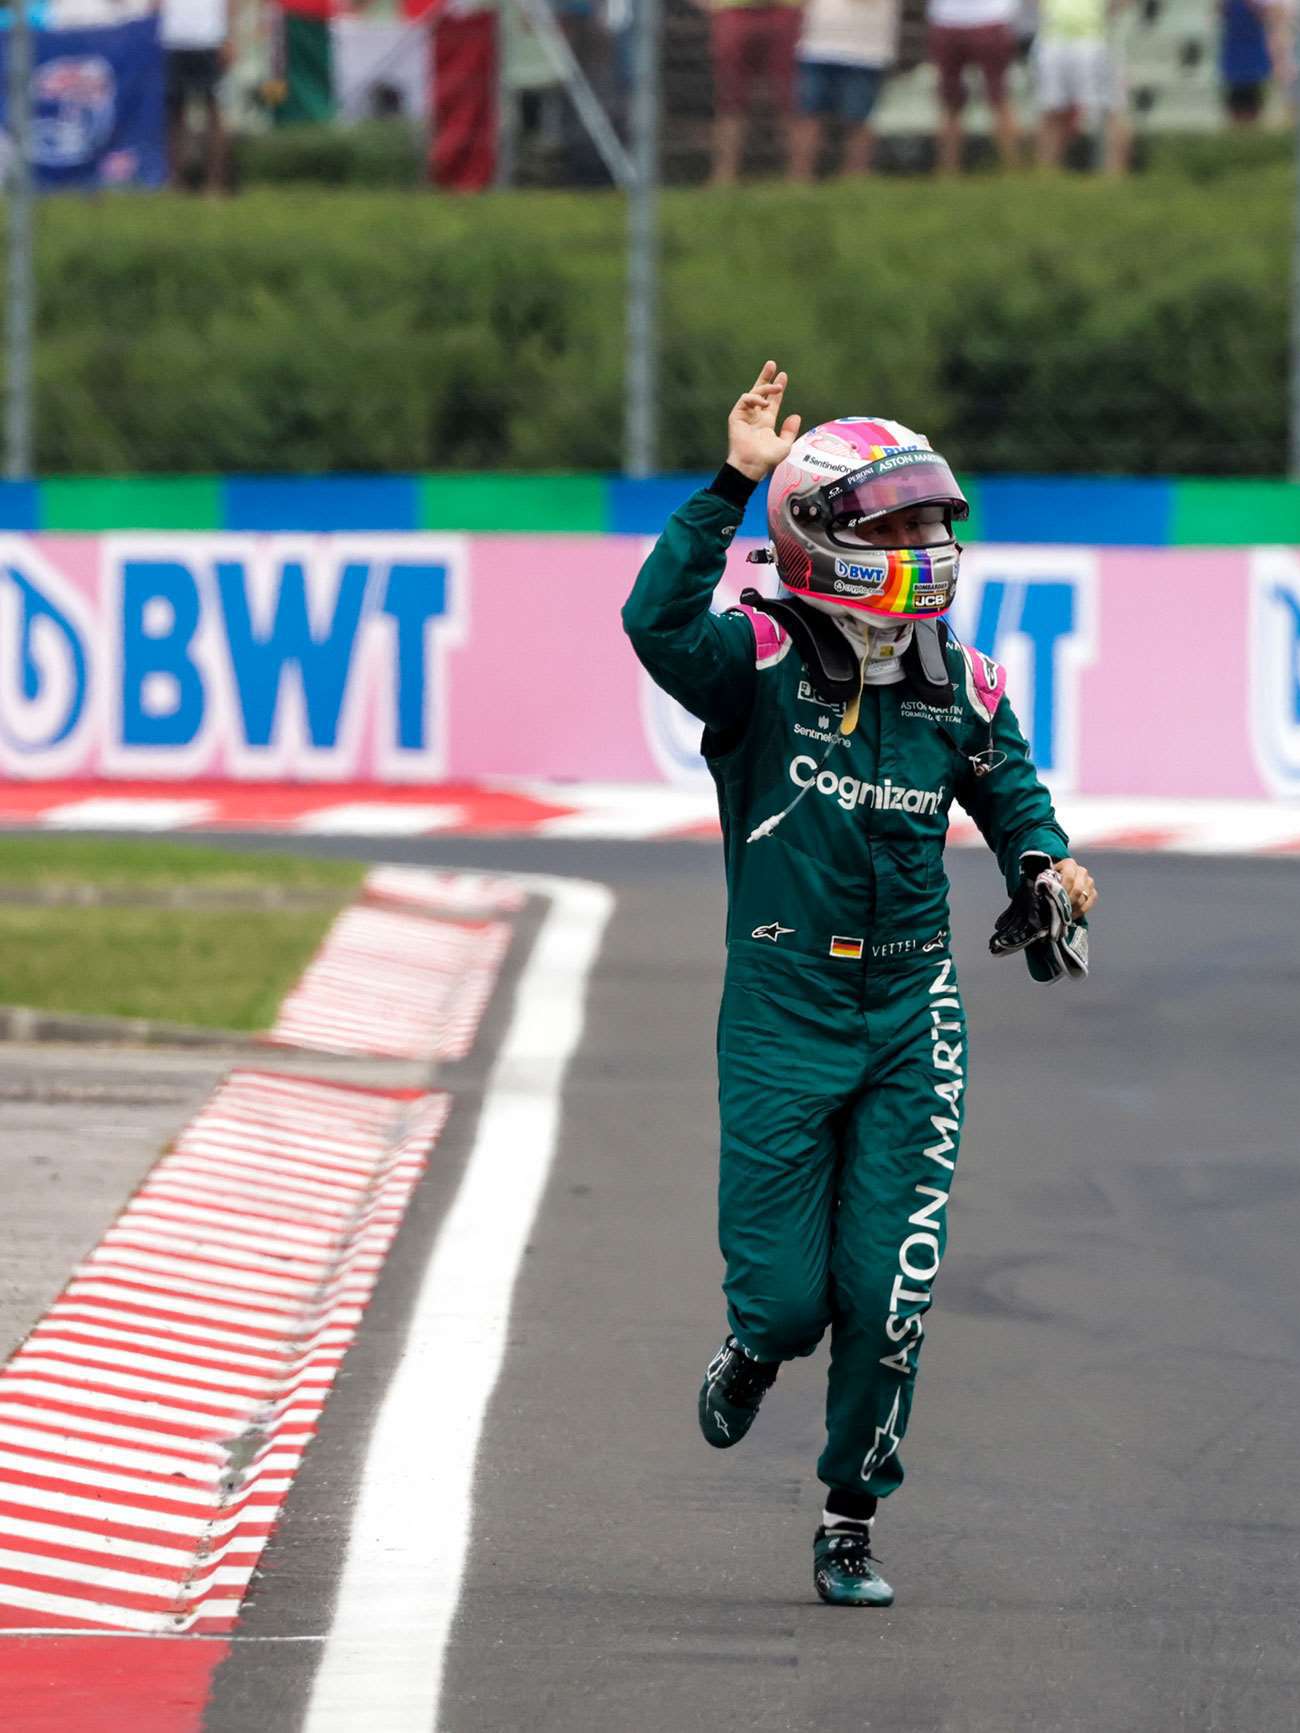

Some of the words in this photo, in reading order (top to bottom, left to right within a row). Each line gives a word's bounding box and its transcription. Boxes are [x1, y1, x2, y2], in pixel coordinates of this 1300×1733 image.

[808, 456, 854, 474] SentinelOn
[879, 454, 913, 472] ASTON
[847, 467, 874, 485] PERONI
[849, 565, 885, 581] BWT
[915, 595, 945, 606] JCB
[119, 559, 449, 751] BWT
[789, 755, 946, 816] Cognizant
[880, 1184, 949, 1374] ASTON
[923, 958, 964, 1171] MARTIN
